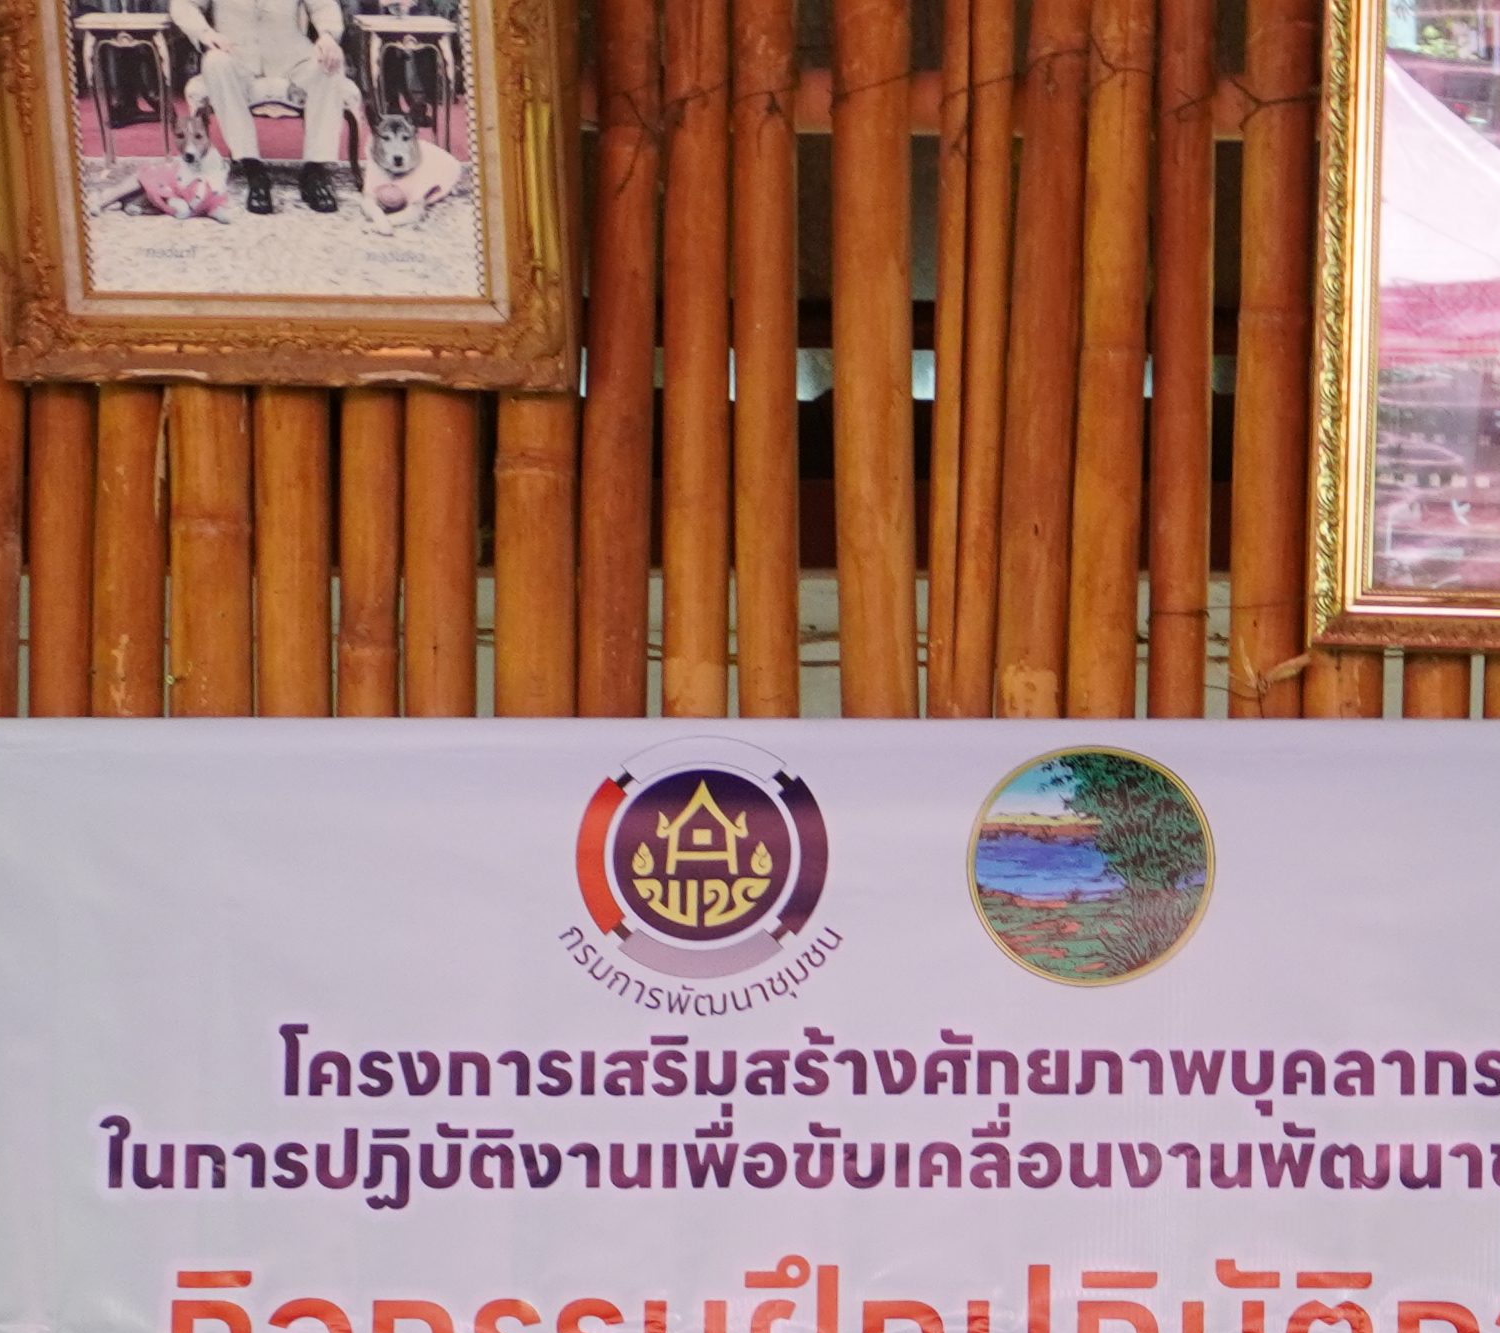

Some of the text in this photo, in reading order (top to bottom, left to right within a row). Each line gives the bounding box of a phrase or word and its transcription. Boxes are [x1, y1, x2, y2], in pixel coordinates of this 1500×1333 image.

[557, 922, 844, 1018] กรมการพัฒนาชุมชน
